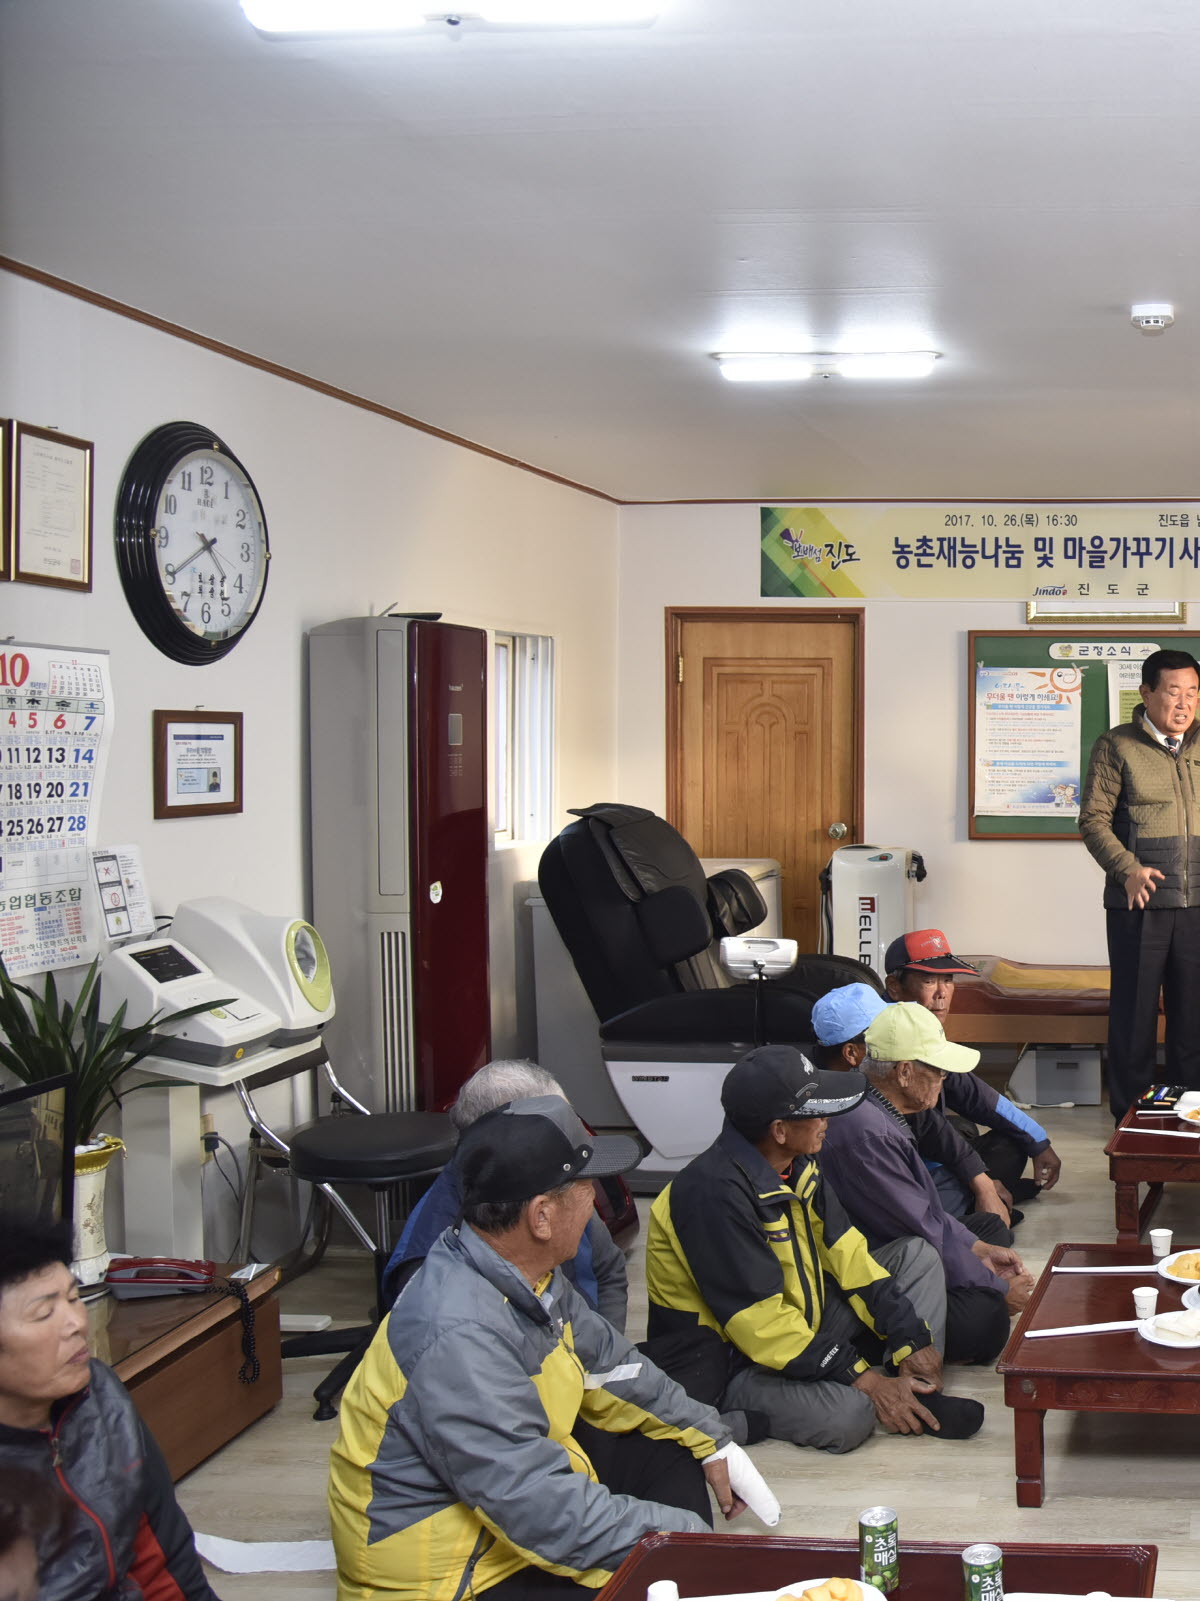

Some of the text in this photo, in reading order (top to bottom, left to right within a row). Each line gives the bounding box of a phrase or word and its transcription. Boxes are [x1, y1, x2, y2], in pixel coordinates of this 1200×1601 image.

[181, 471, 192, 492] 11
[200, 466, 214, 486] 12
[164, 494, 177, 515] 10
[235, 509, 246, 529] 2
[944, 513, 1078, 527] 2017. 10. 26.(목) 16:30
[1158, 514, 1189, 528] 진도읍
[158, 526, 169, 548] 9
[240, 542, 251, 563] 3
[824, 541, 861, 570] 진도
[892, 535, 1024, 570] 농촌재능나눔
[1034, 536, 1054, 569] 및
[165, 563, 176, 586] 8
[233, 573, 244, 594] 4
[181, 591, 192, 613] 7
[201, 602, 211, 624] 6
[1079, 646, 1131, 657] 군정소식
[0, 652, 30, 687] 10
[8, 711, 97, 731] 4 5 6 7
[7, 747, 94, 763] 11 12 13 14
[7, 781, 89, 800] 18 19 20 21
[6, 815, 86, 836] 25 26 27 28
[874, 1532, 897, 1551] 초록
[874, 1549, 897, 1566] 매실
